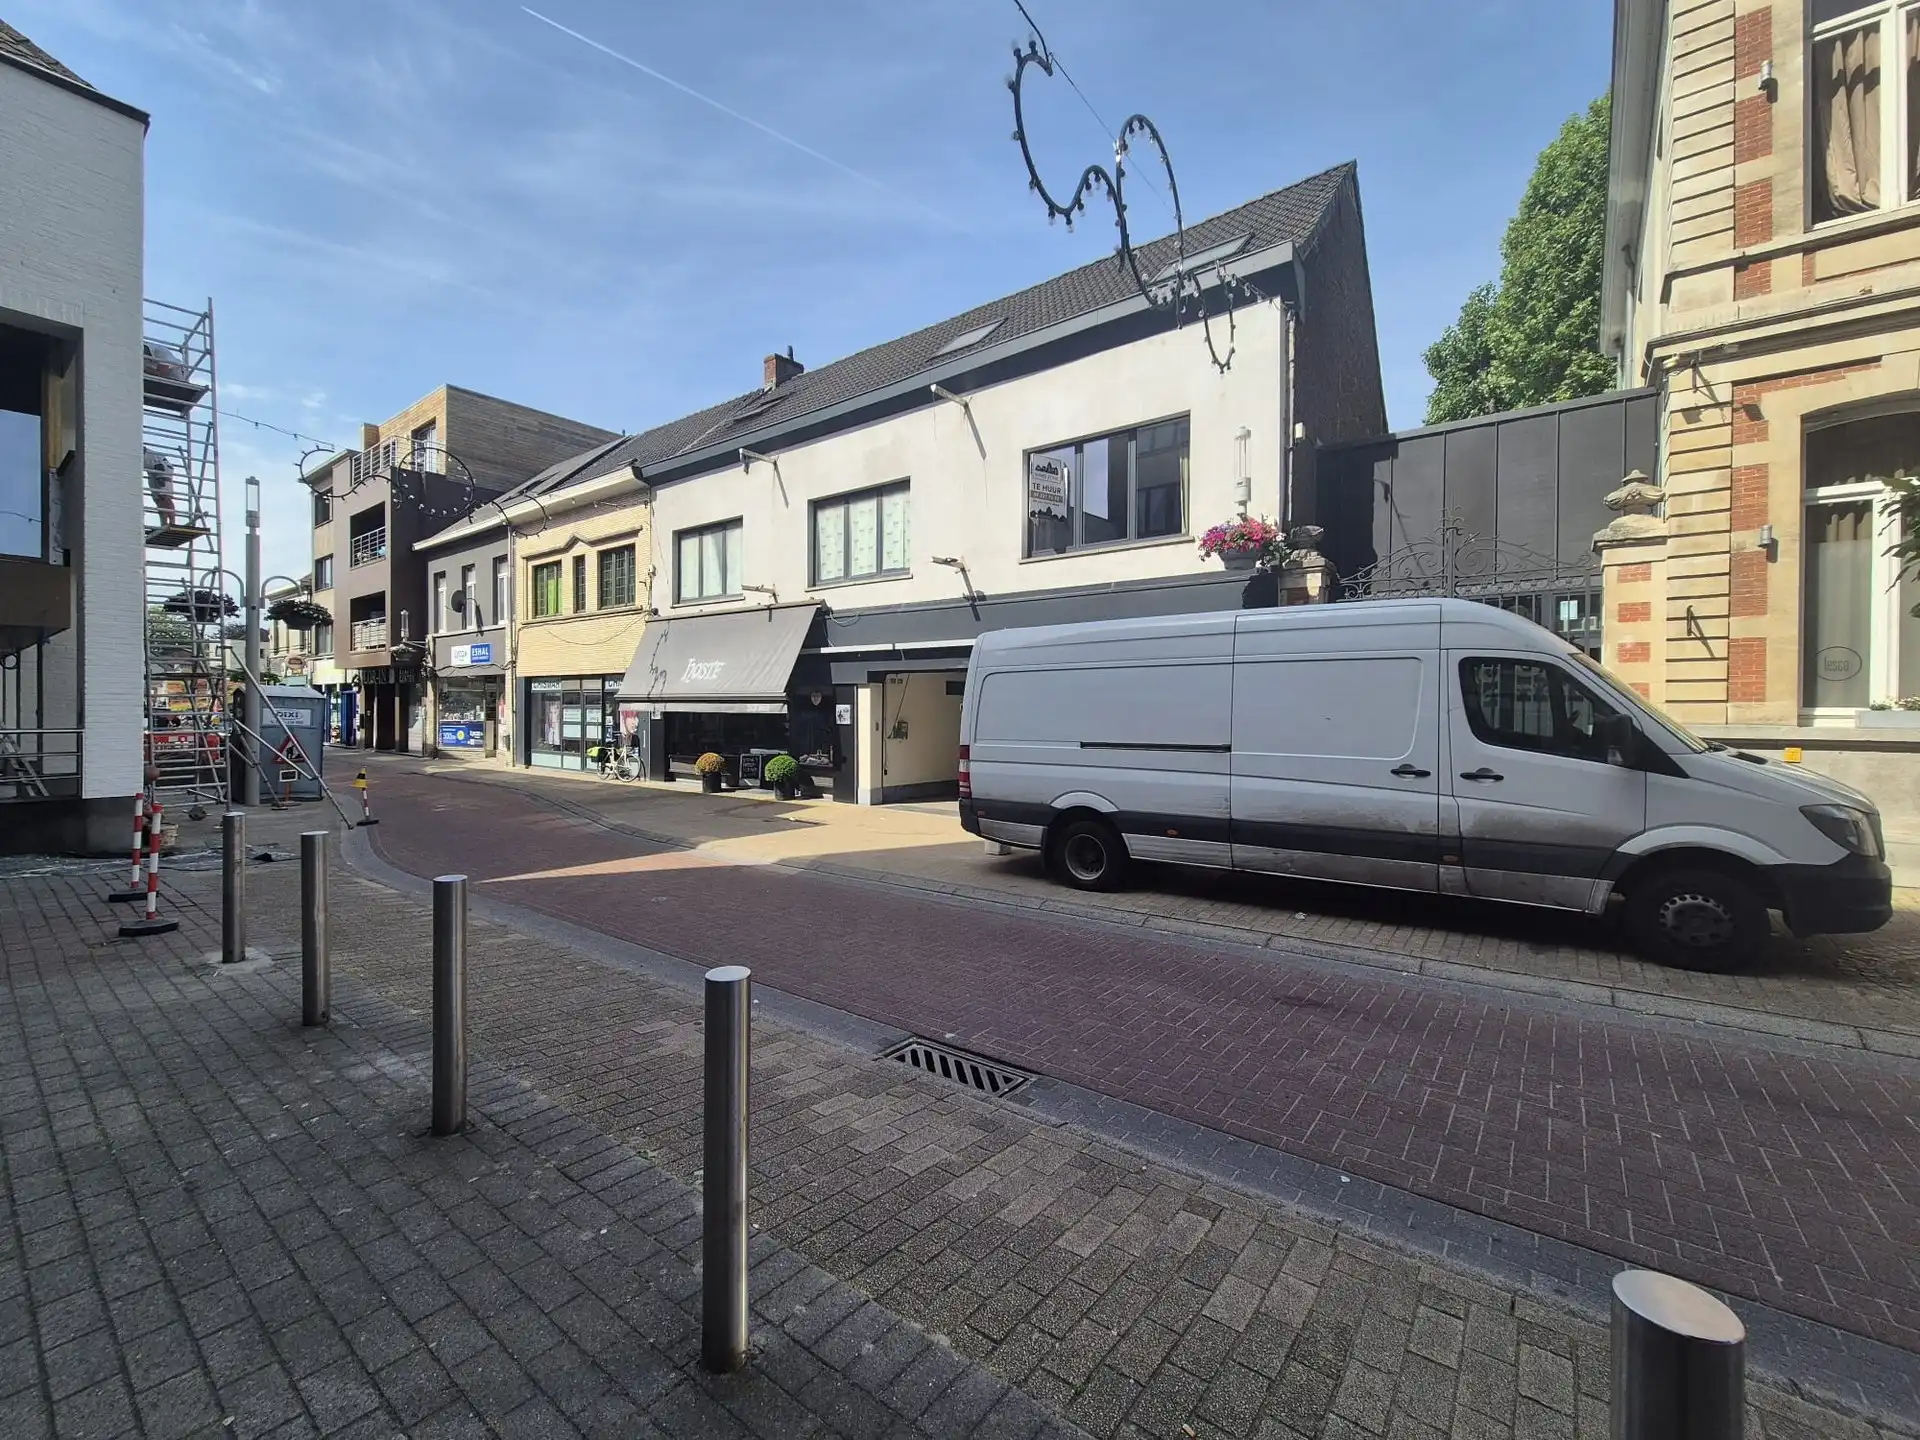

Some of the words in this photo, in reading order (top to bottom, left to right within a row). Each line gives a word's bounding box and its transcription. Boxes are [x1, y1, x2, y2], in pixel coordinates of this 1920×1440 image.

[1032, 482, 1041, 491] TE
[1042, 485, 1062, 495] HUUR
[471, 646, 489, 657] ESHAL
